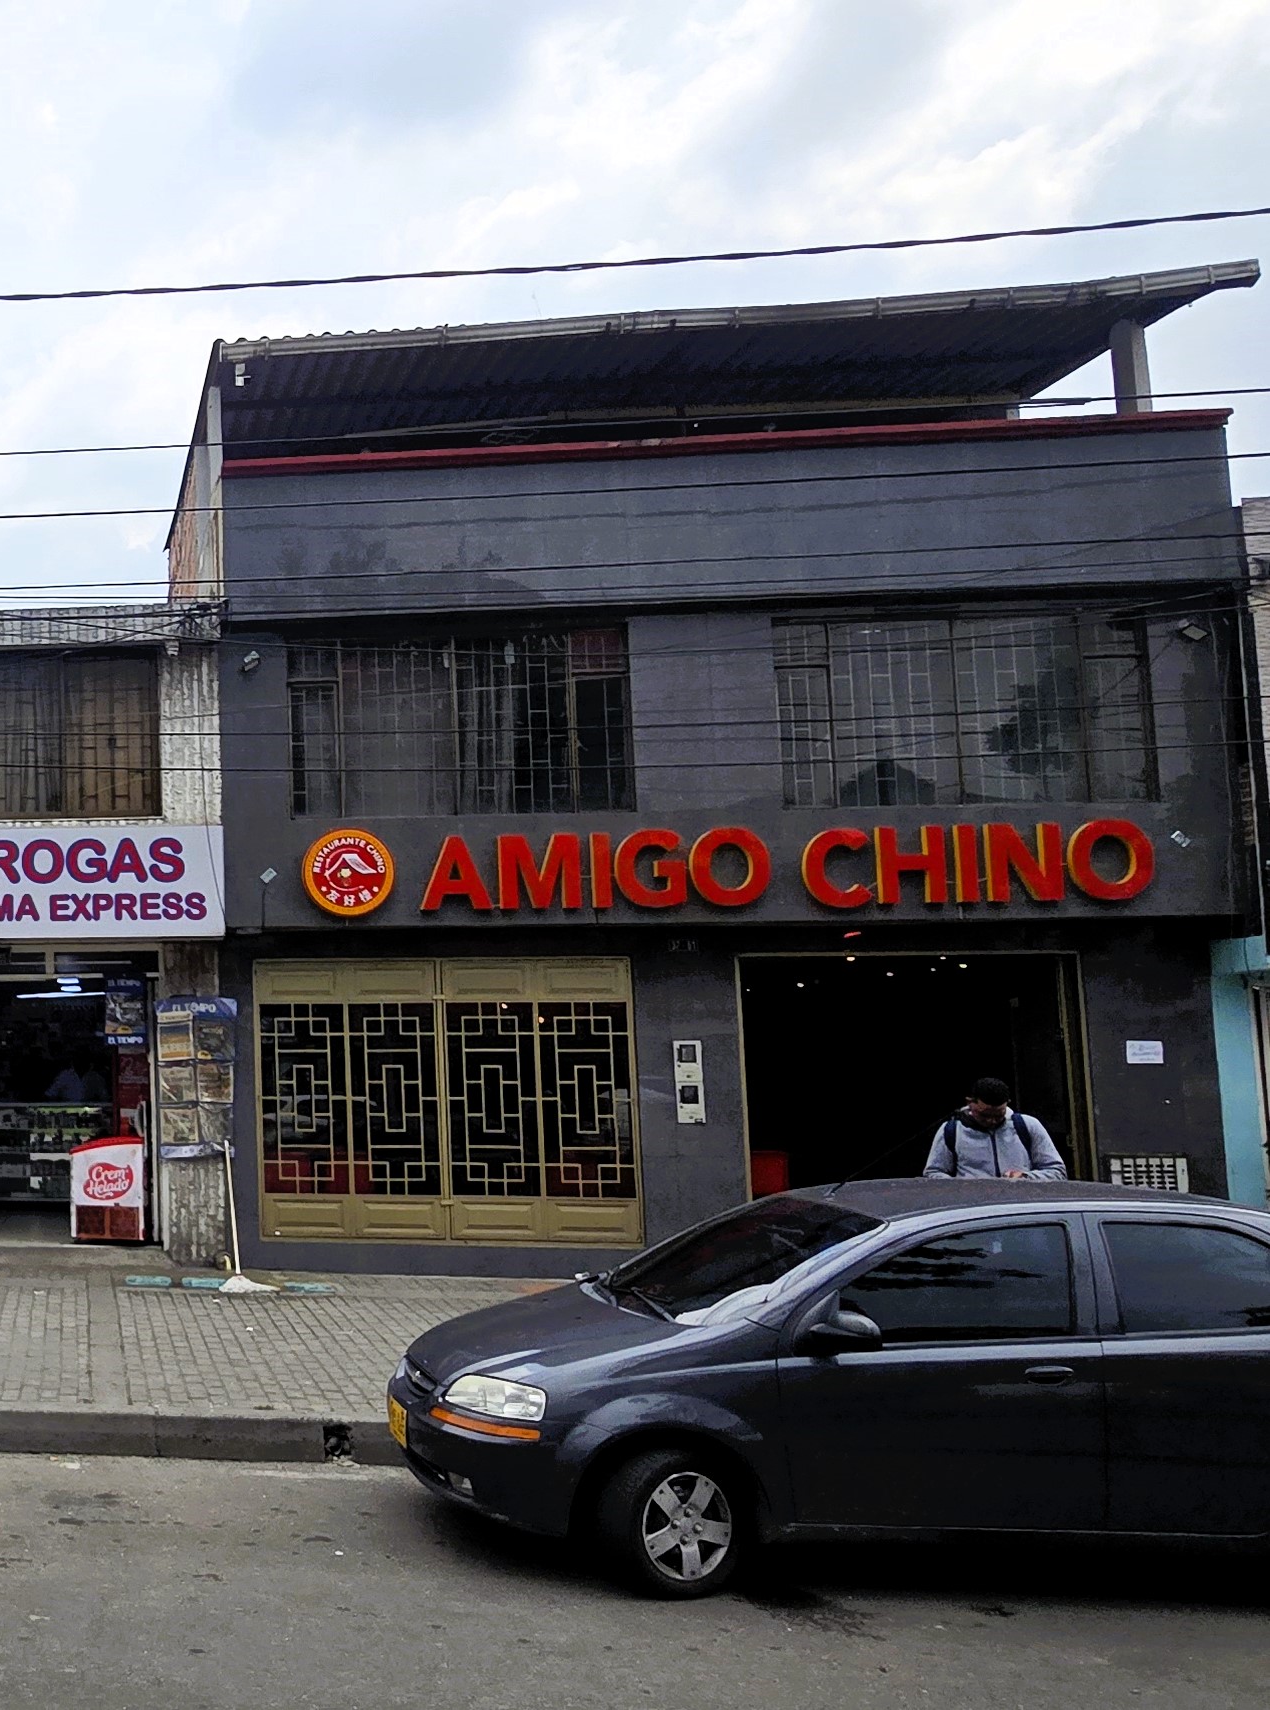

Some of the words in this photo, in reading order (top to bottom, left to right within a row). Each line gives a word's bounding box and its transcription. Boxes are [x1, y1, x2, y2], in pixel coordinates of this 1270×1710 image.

[420, 827, 772, 910] AMIGO
[801, 817, 1155, 908] CHINO
[49, 892, 208, 922] EXPRESS
[91, 1165, 127, 1182] Crem
[86, 1179, 130, 1198] Helado
